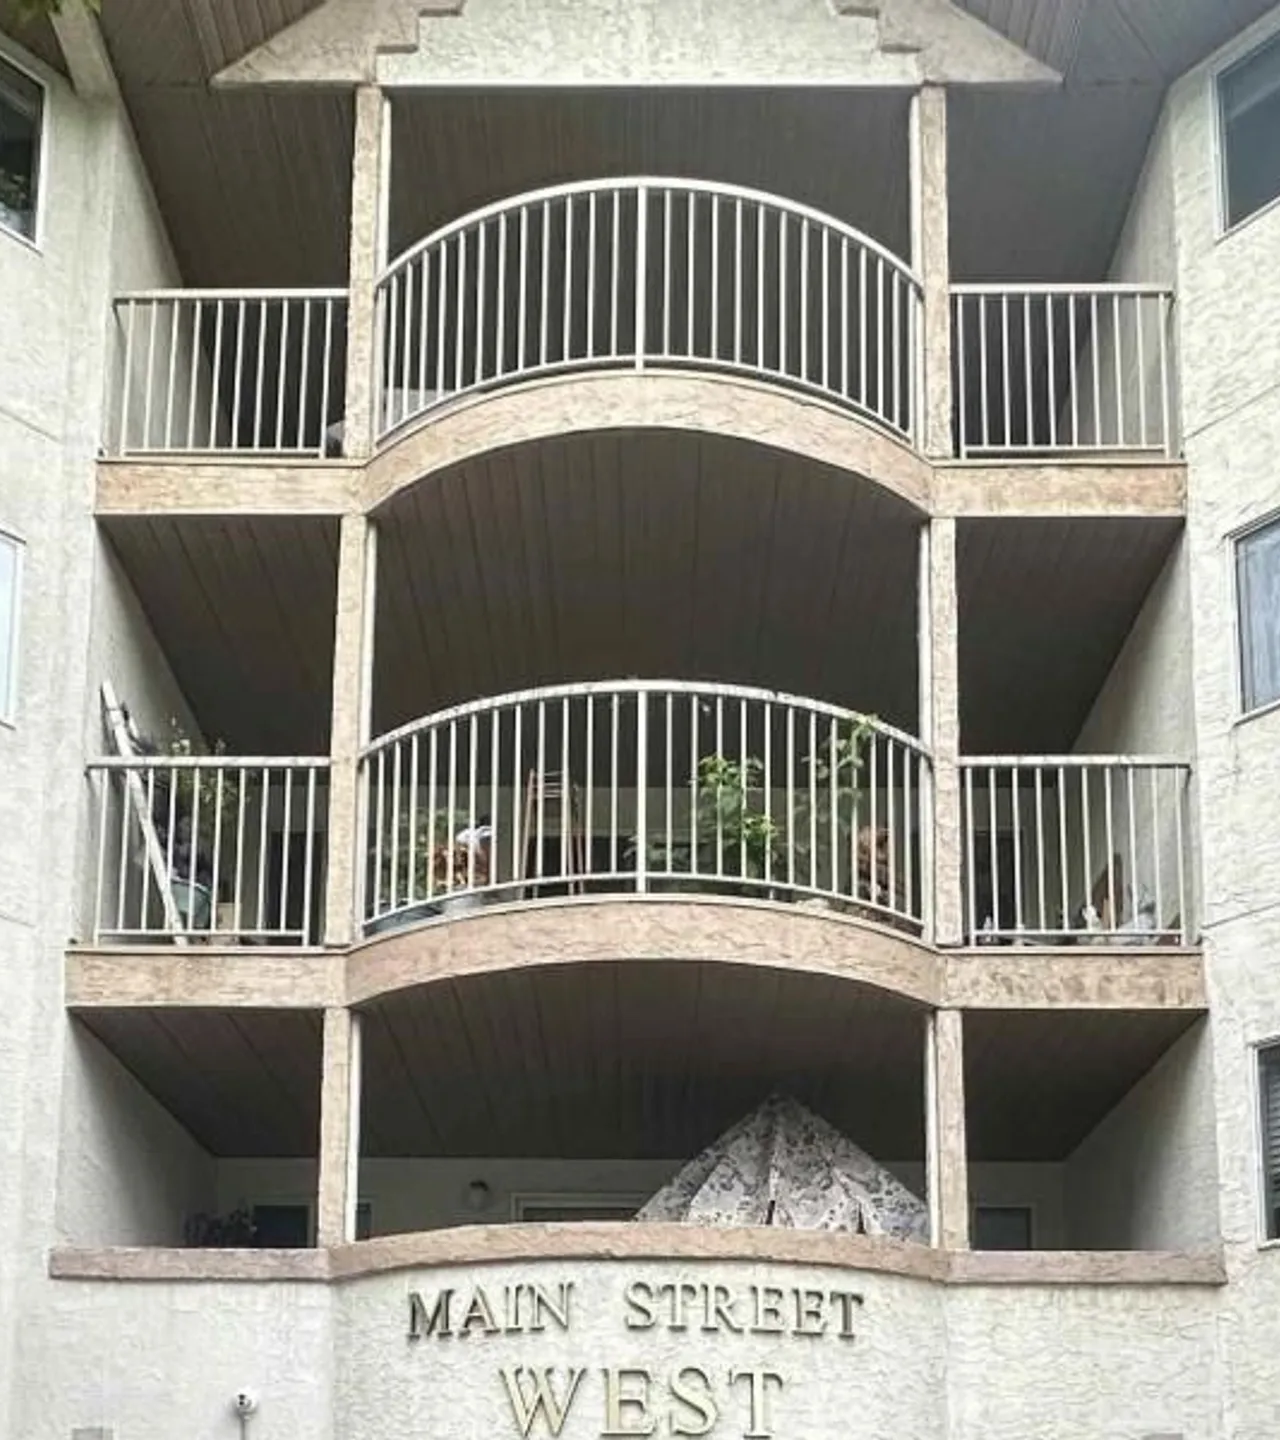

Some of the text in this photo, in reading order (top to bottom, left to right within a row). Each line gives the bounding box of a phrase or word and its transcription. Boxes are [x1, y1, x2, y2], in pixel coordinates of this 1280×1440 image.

[408, 1281, 865, 1343] MAIN STREET
[499, 1366, 786, 1440] WEST
